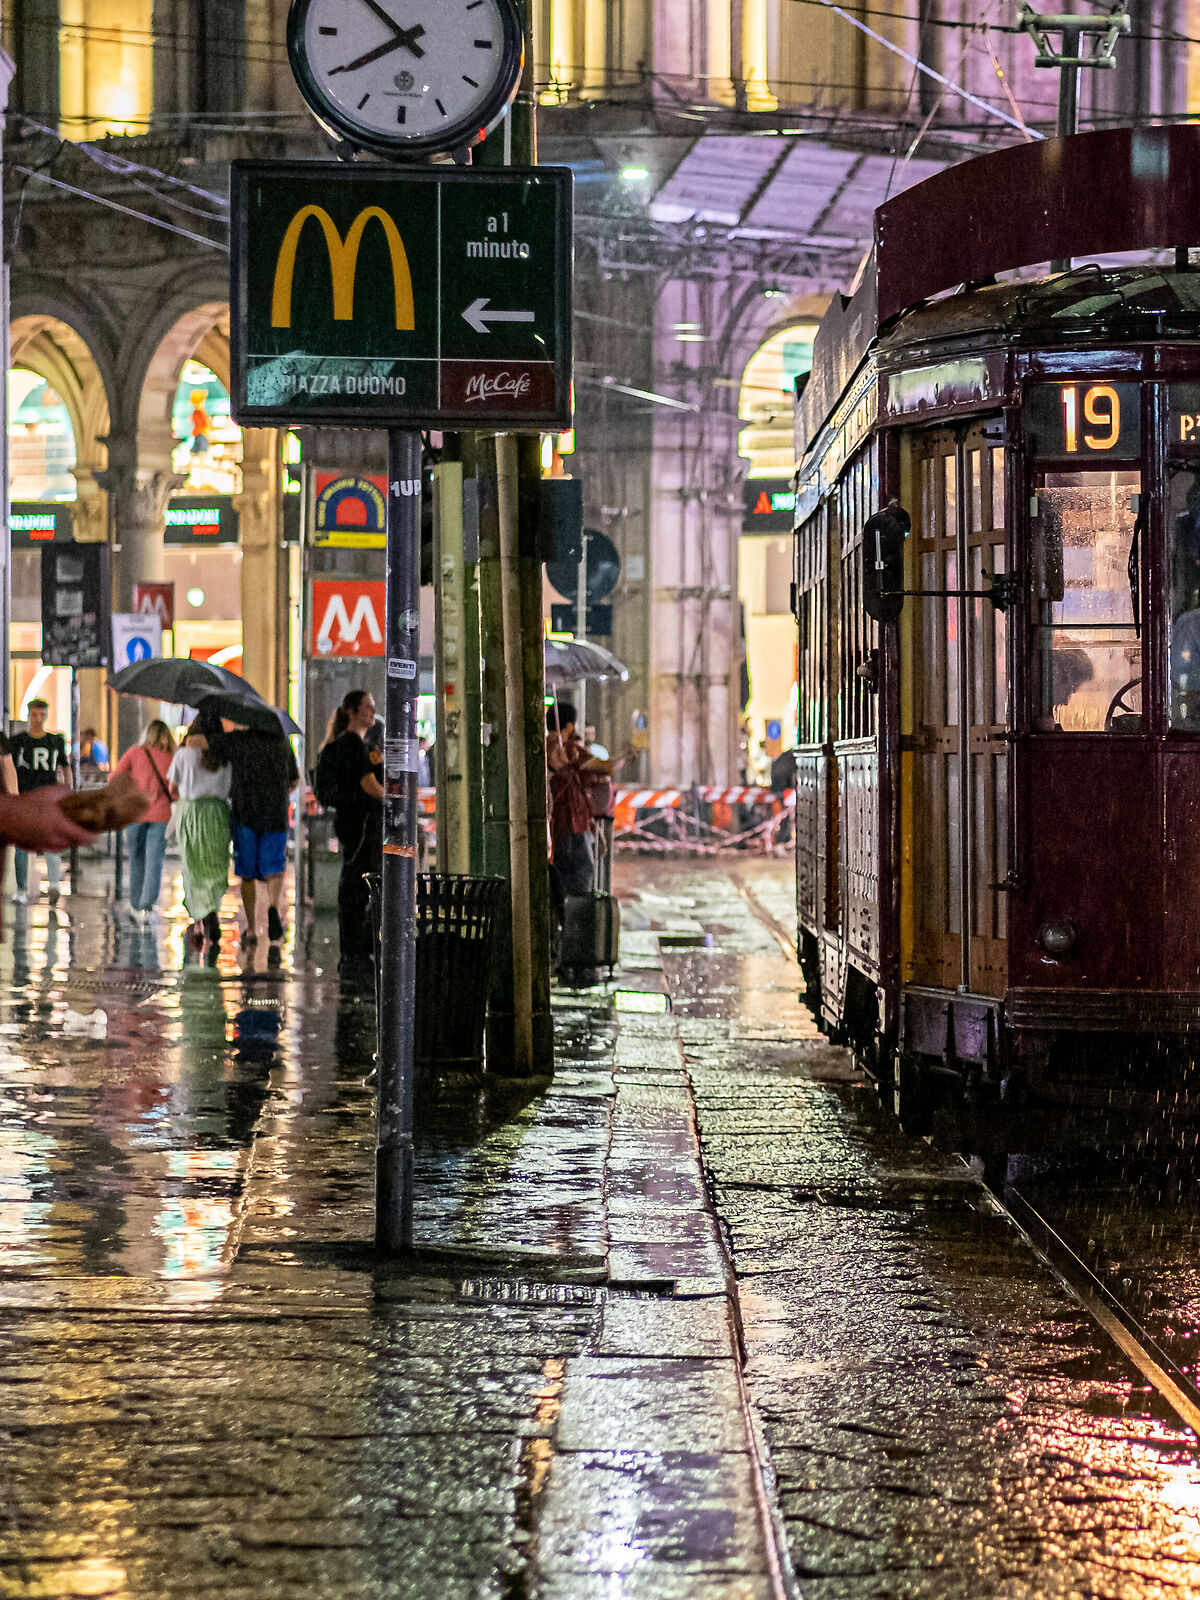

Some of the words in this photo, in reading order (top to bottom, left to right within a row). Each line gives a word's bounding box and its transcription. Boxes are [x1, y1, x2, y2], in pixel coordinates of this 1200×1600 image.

[487, 216, 498, 233] a
[502, 212, 508, 233] 1
[466, 236, 530, 259] minuto
[281, 374, 341, 395] PIAZZA
[346, 375, 406, 396] DUOMO
[465, 372, 531, 402] McCafé
[1062, 386, 1120, 451] 19
